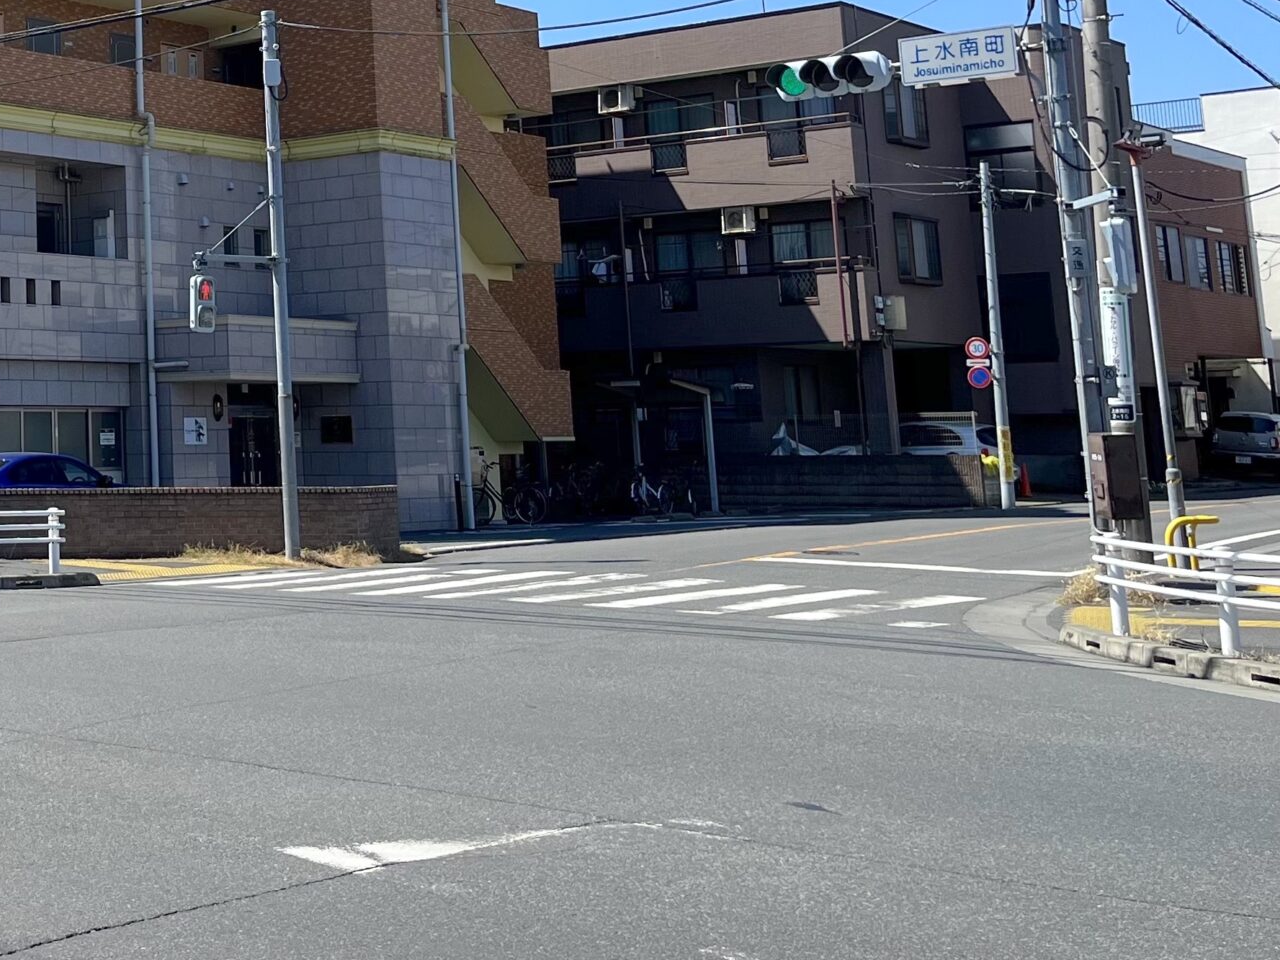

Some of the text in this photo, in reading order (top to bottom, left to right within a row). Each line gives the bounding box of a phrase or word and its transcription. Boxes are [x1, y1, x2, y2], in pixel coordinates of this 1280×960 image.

[910, 35, 1005, 64] 上水南町
[913, 58, 1006, 77] Josuiminamicho
[971, 343, 984, 354] 30
